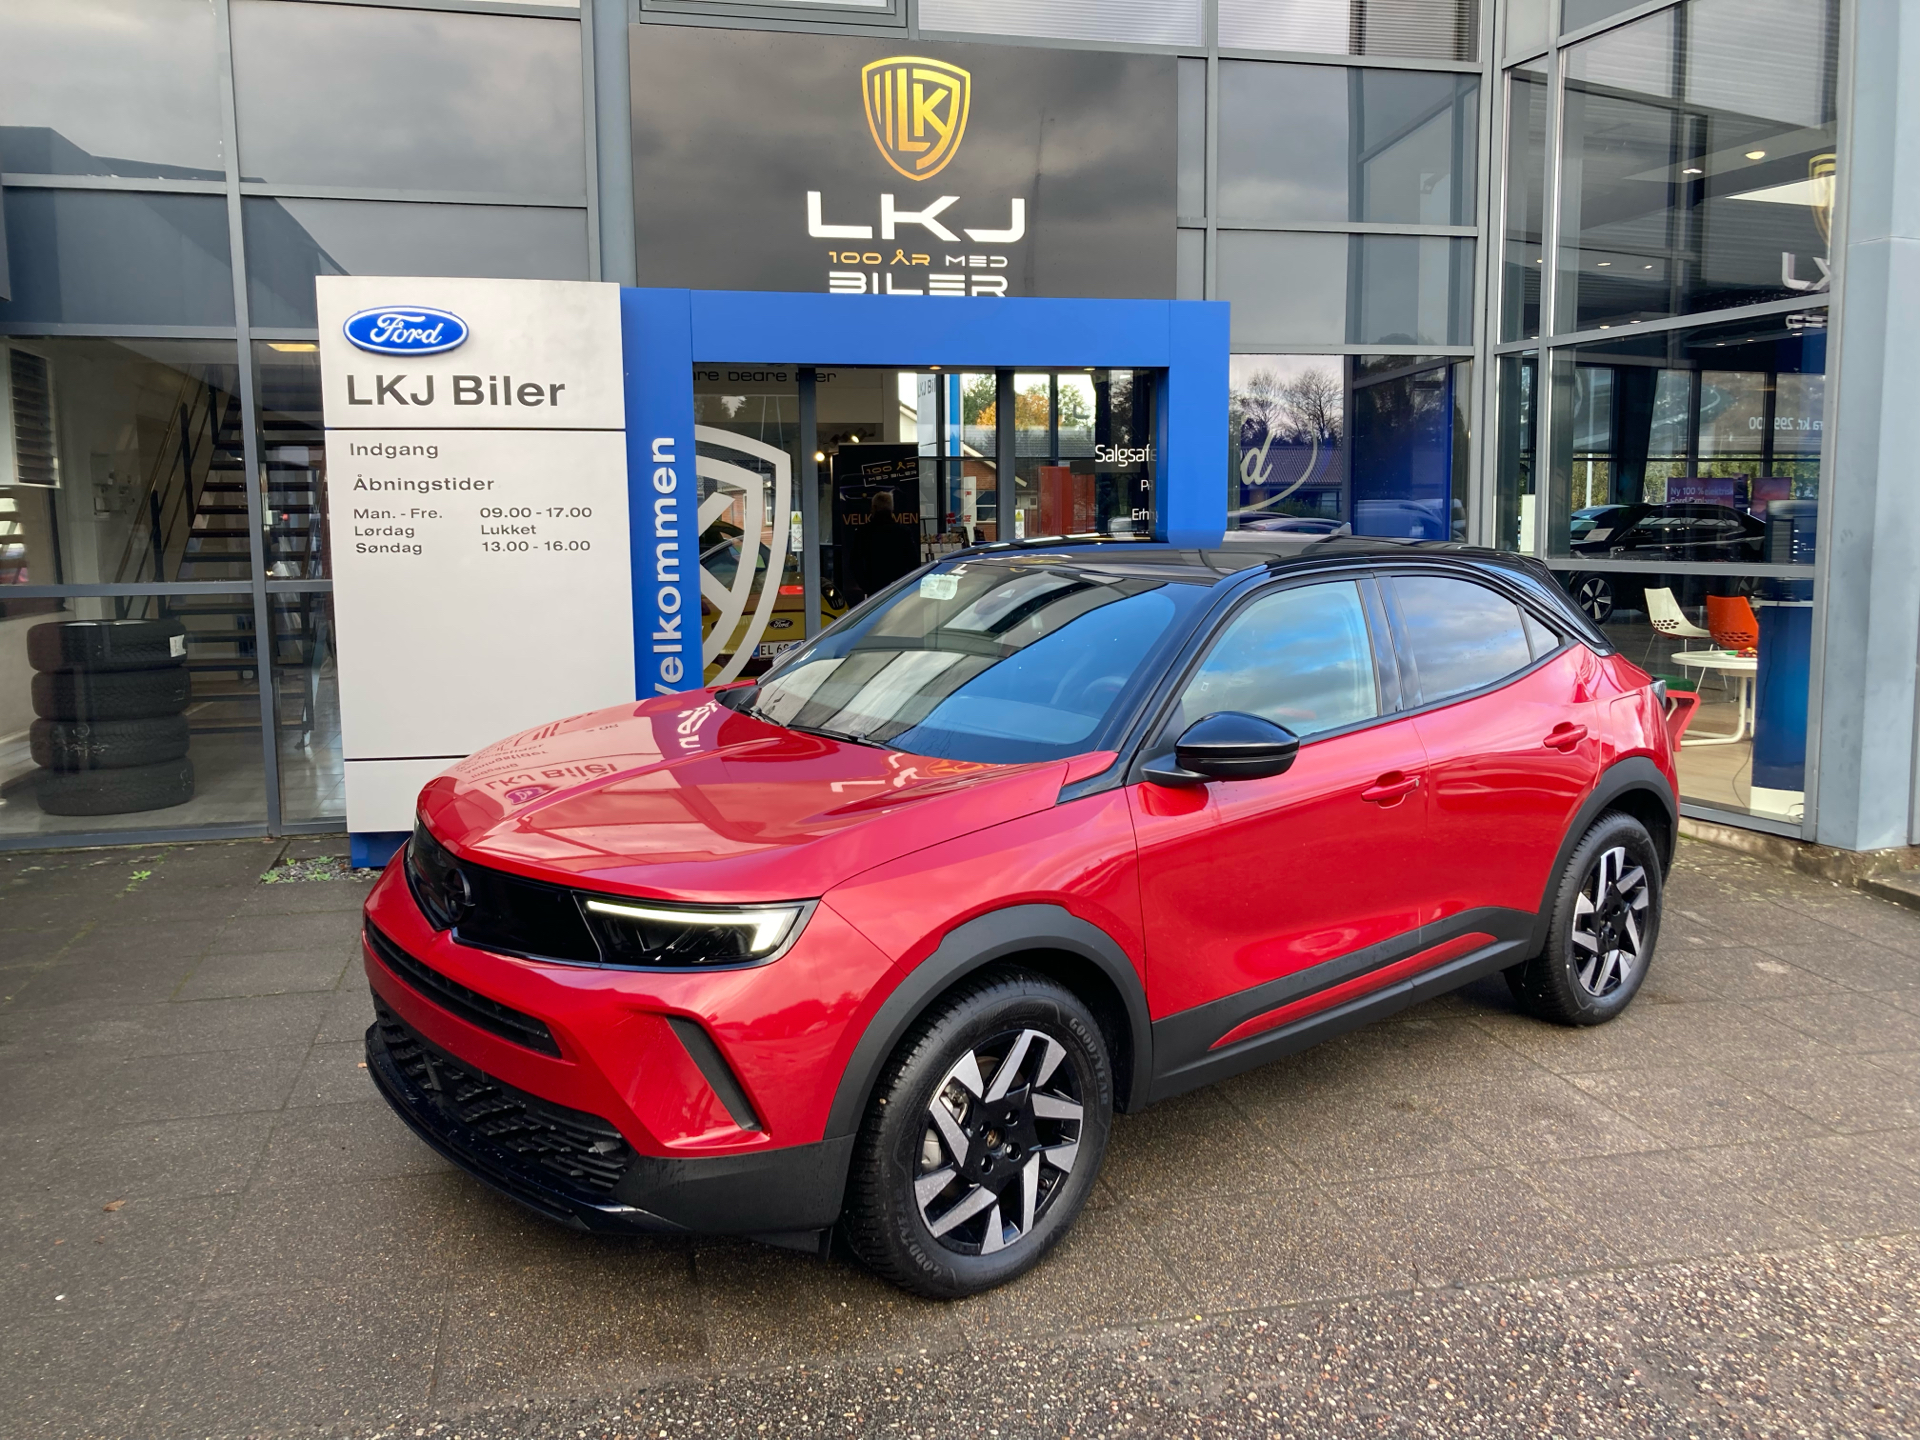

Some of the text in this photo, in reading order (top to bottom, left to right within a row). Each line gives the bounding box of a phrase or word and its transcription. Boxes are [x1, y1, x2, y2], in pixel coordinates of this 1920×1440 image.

[807, 190, 1025, 243] LKJ
[829, 249, 1008, 268] 100 ÅR MED
[829, 271, 1008, 297] BILER
[369, 313, 445, 345] Ford
[346, 374, 566, 407] LKJ Biler
[349, 443, 439, 459] Indgang
[866, 465, 892, 474] 100
[353, 473, 495, 494] Åbningstider
[1670, 487, 1681, 497] Ny
[1683, 487, 1696, 496] 100
[353, 508, 396, 519] Man.
[410, 508, 443, 519] Fre.
[479, 507, 532, 519] 09.00
[545, 507, 593, 518] 17.00
[842, 512, 919, 525] VELKMEN
[354, 524, 537, 539] Lørdag Lukket
[355, 542, 423, 555] Søndag
[482, 541, 529, 552] 13.00
[543, 540, 591, 552] 16.00
[760, 645, 774, 656] EL
